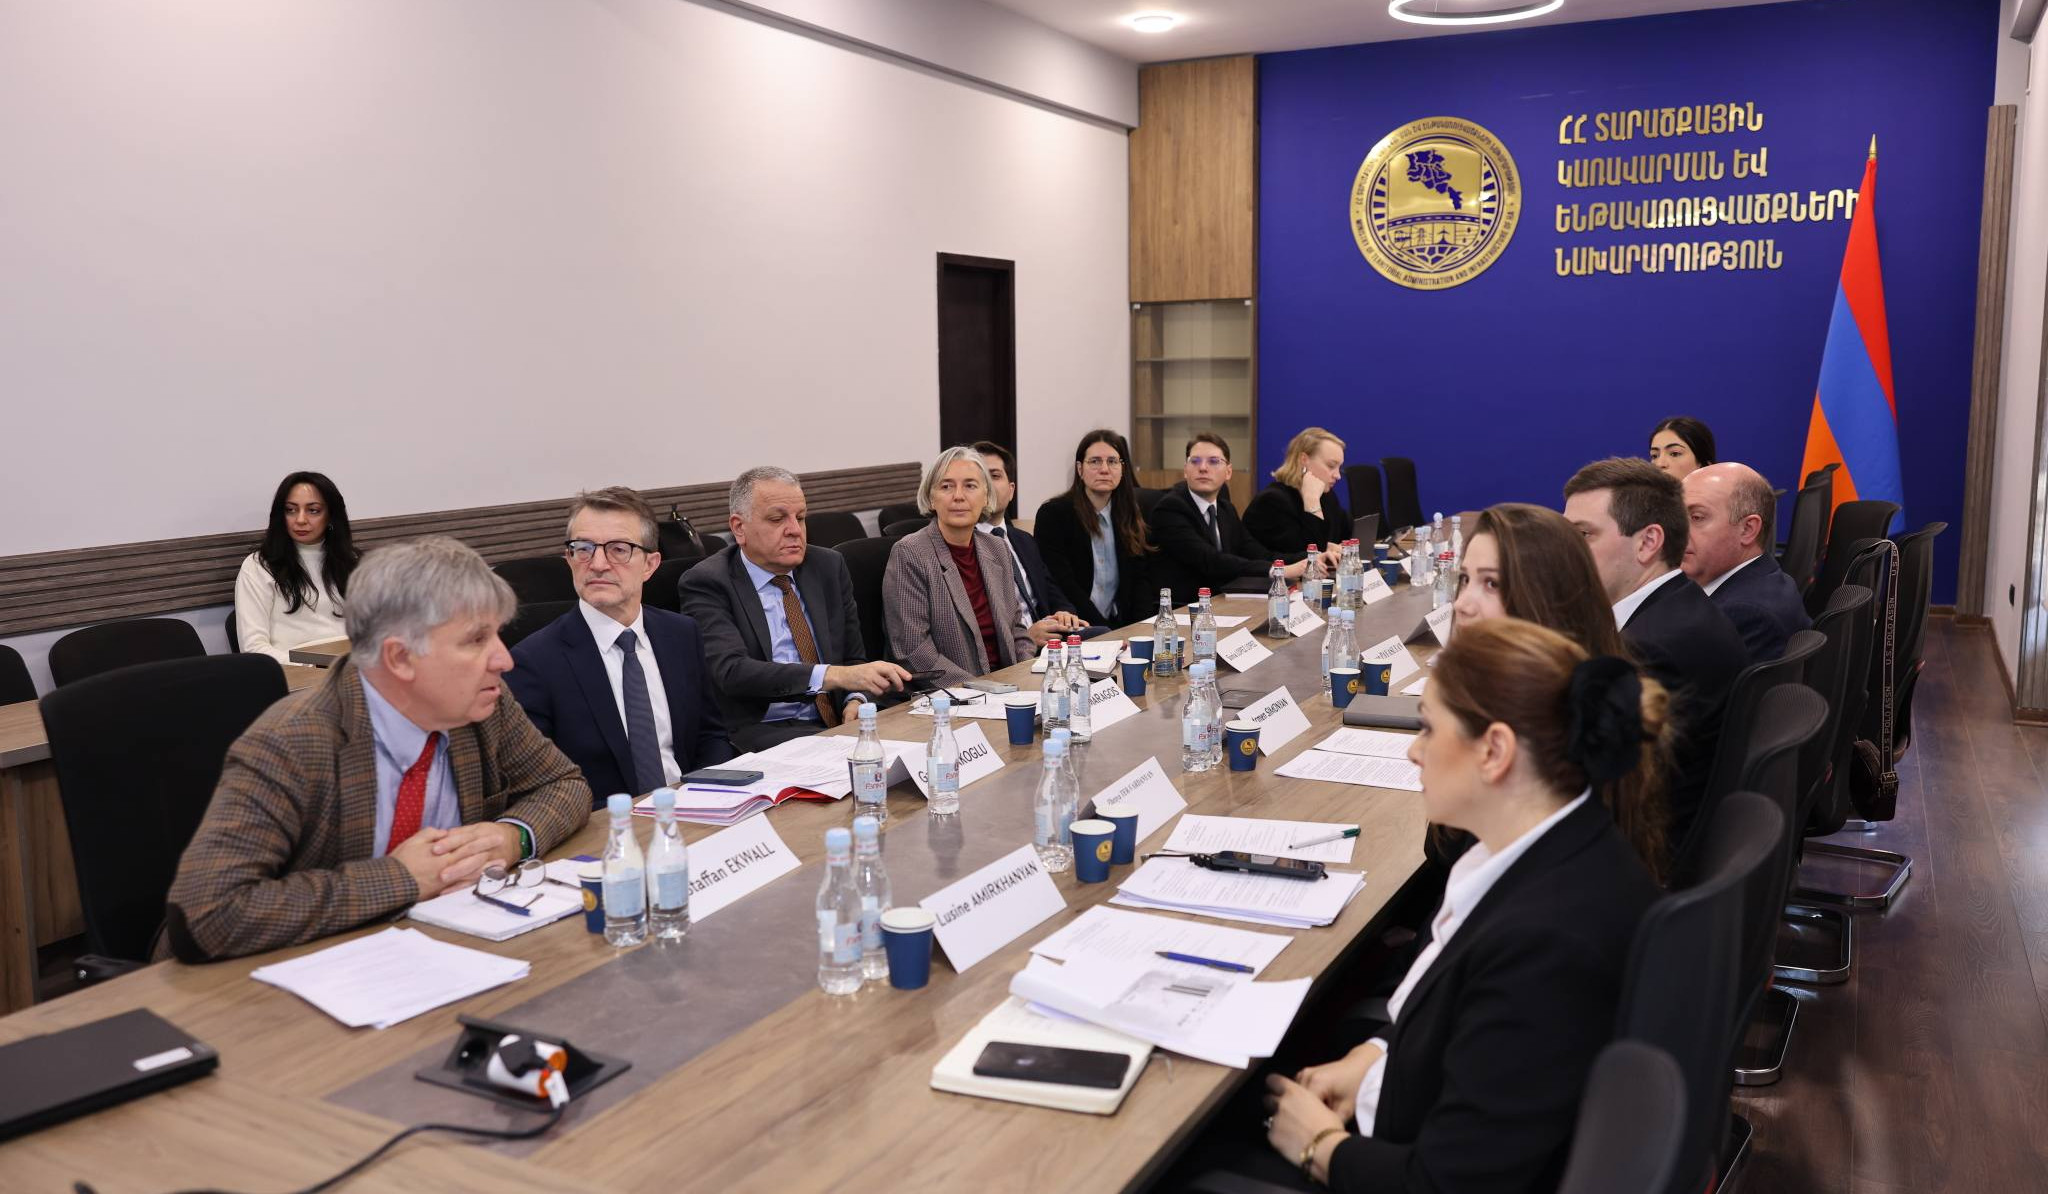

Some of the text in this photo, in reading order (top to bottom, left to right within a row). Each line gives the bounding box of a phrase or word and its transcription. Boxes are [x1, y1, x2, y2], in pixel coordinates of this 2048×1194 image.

[1559, 101, 1763, 145] ՀՀ ՏԱՐԱԾՔԱՅԻՆ
[1557, 150, 1724, 188] ԿԱՌԱՎԱՐՄԱՆ
[1733, 146, 1768, 179] ԵՎ
[1555, 239, 1783, 276] ՆԱԽԱՐԱՐՈՒԹՅՈՒՆ
[725, 842, 776, 874] EKWALL
[935, 860, 1039, 927] Lusine AMIRKHANYAN
